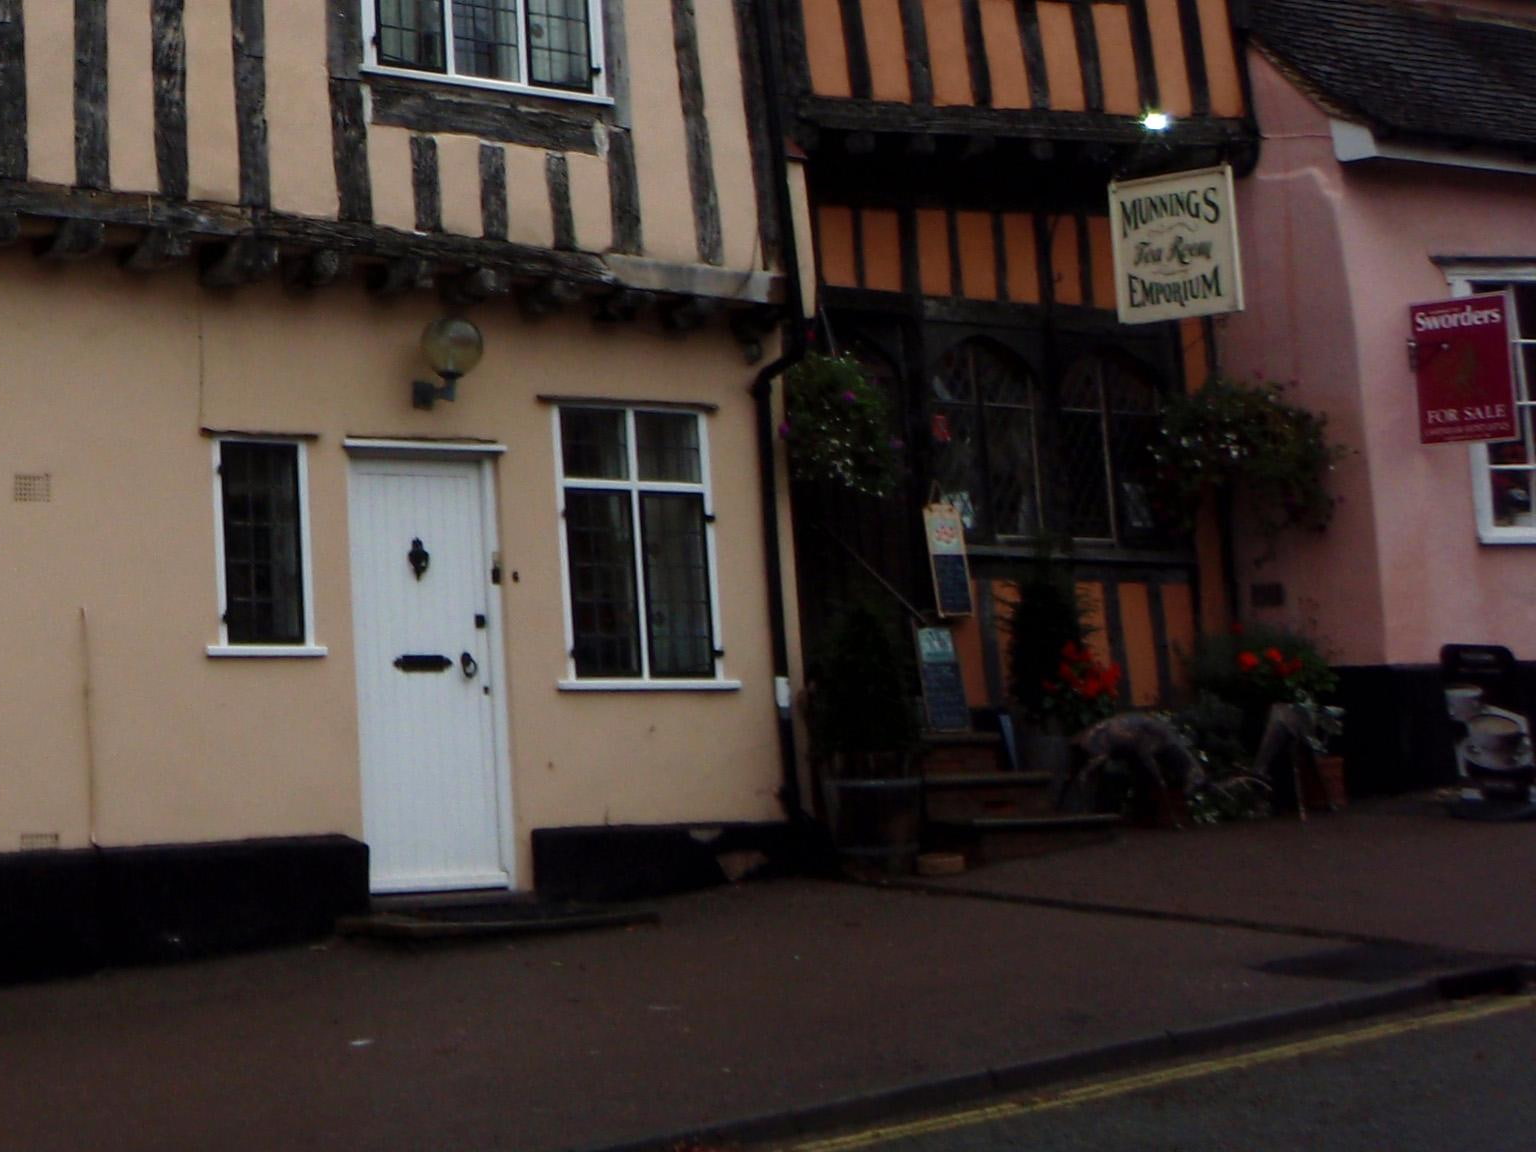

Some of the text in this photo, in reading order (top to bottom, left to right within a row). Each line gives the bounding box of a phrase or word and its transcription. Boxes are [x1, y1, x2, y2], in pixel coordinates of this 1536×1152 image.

[1120, 187, 1221, 238] MUNNINGS
[1127, 265, 1222, 308] EMPORIUM
[1415, 305, 1502, 332] Sworders
[1426, 403, 1506, 424] FOR SALE
